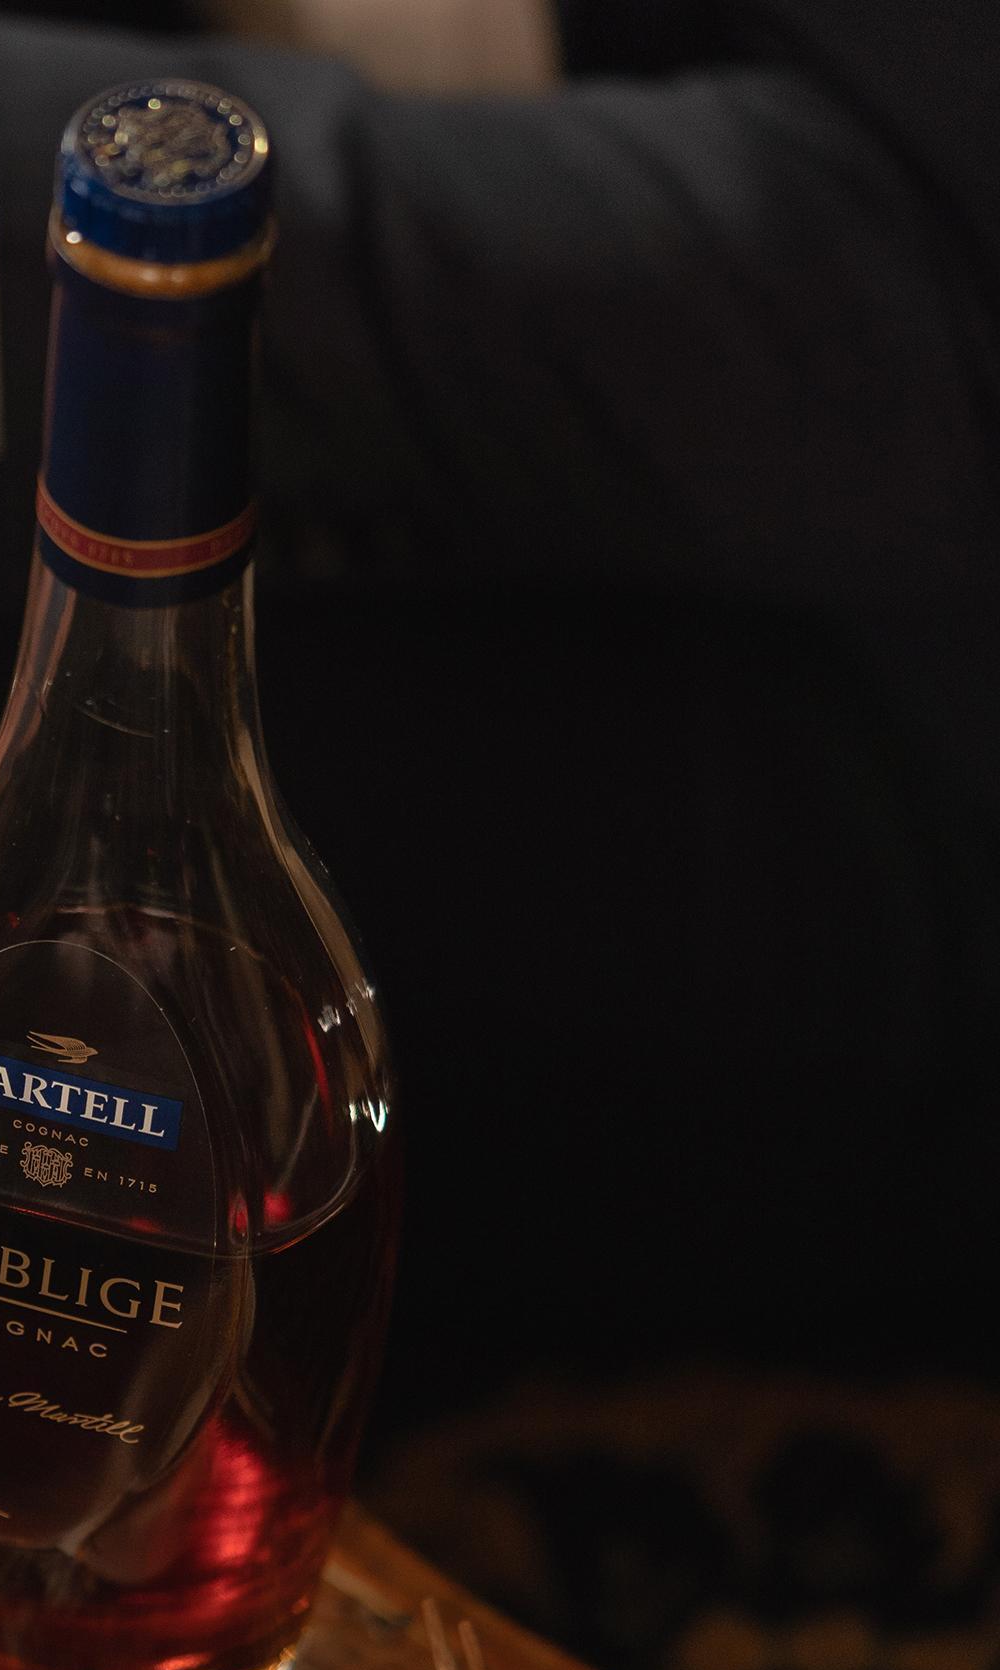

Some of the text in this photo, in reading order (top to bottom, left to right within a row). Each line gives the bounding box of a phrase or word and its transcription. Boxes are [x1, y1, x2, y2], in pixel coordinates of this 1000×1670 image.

[12, 1119, 90, 1147] COGNAC
[83, 1167, 108, 1181] EN
[118, 1176, 158, 1193] 1715
[8, 1392, 145, 1444] Martell
